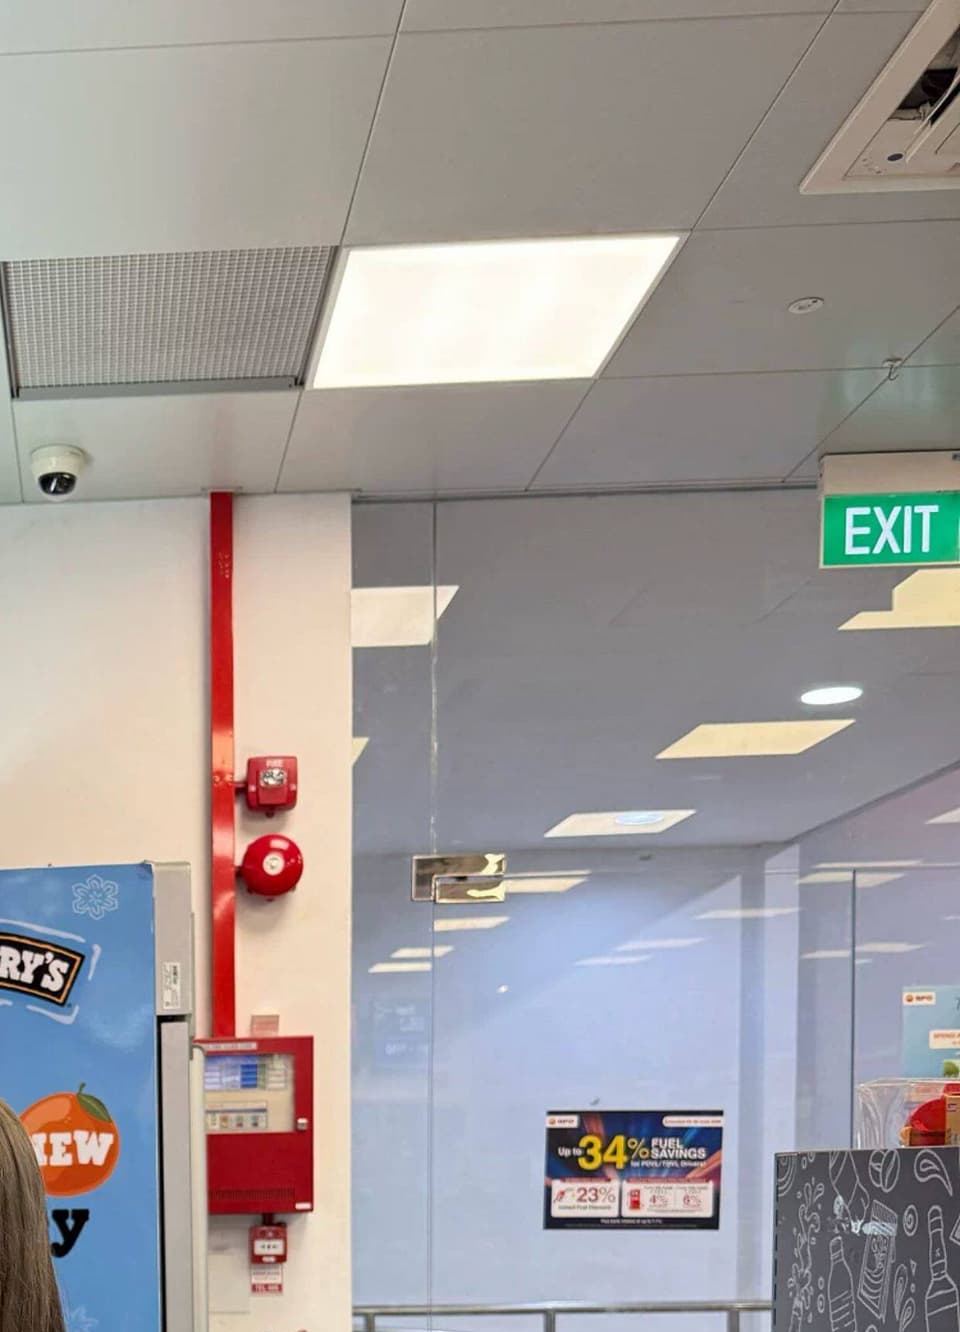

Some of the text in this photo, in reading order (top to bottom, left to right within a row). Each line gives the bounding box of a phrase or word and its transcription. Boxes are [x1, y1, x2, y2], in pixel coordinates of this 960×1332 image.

[845, 505, 939, 555] EXIT
[651, 1137, 683, 1149] FUEL
[557, 1146, 571, 1157] Up
[572, 1147, 583, 1156] to
[650, 1147, 707, 1160] SAVINGS
[576, 1187, 617, 1204] 23%
